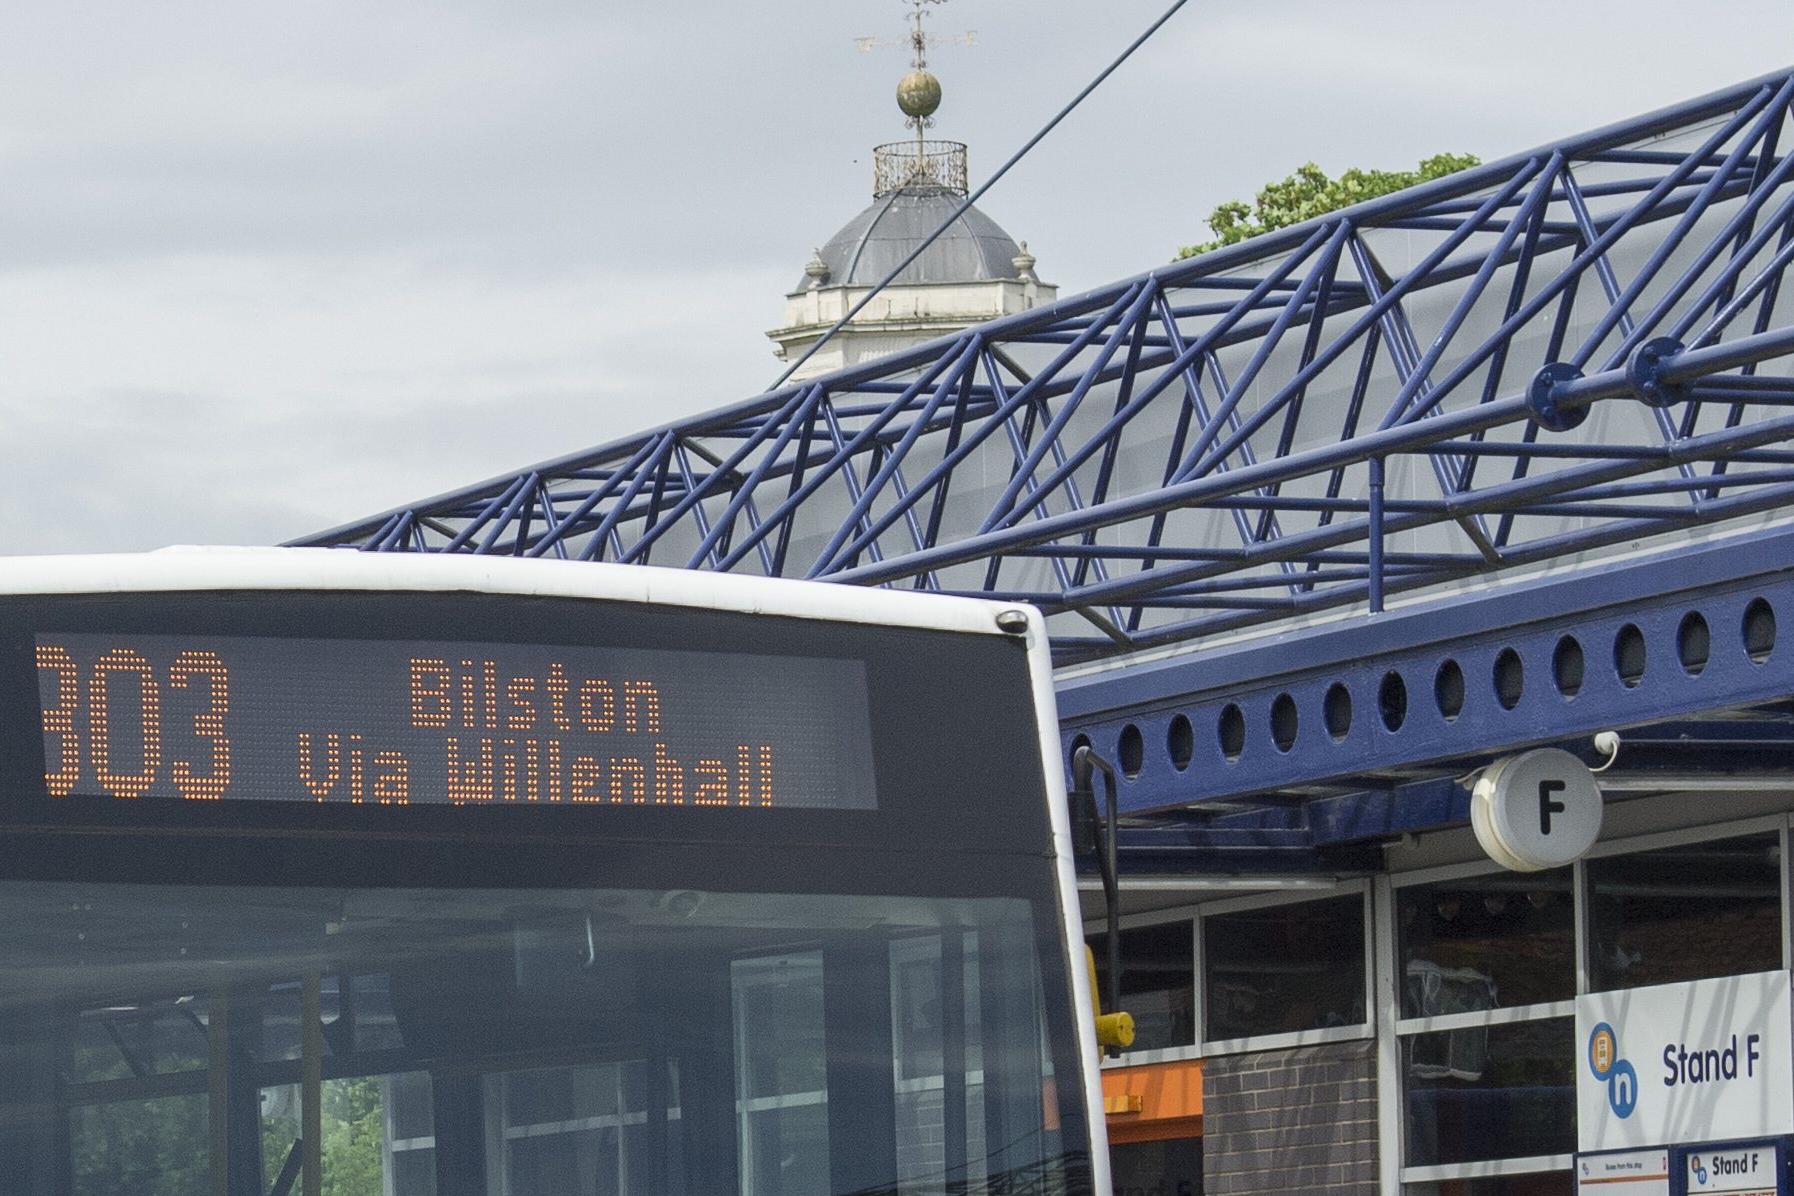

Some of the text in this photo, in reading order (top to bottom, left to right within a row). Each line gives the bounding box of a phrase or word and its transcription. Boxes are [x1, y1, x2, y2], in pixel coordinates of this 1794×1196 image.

[34, 646, 231, 800] 303
[410, 656, 660, 734] Bilston
[298, 732, 773, 807] Via Willenhall
[1538, 779, 1566, 836] F
[1663, 1033, 1760, 1087] Stand F
[1712, 1153, 1759, 1176] Stand F
